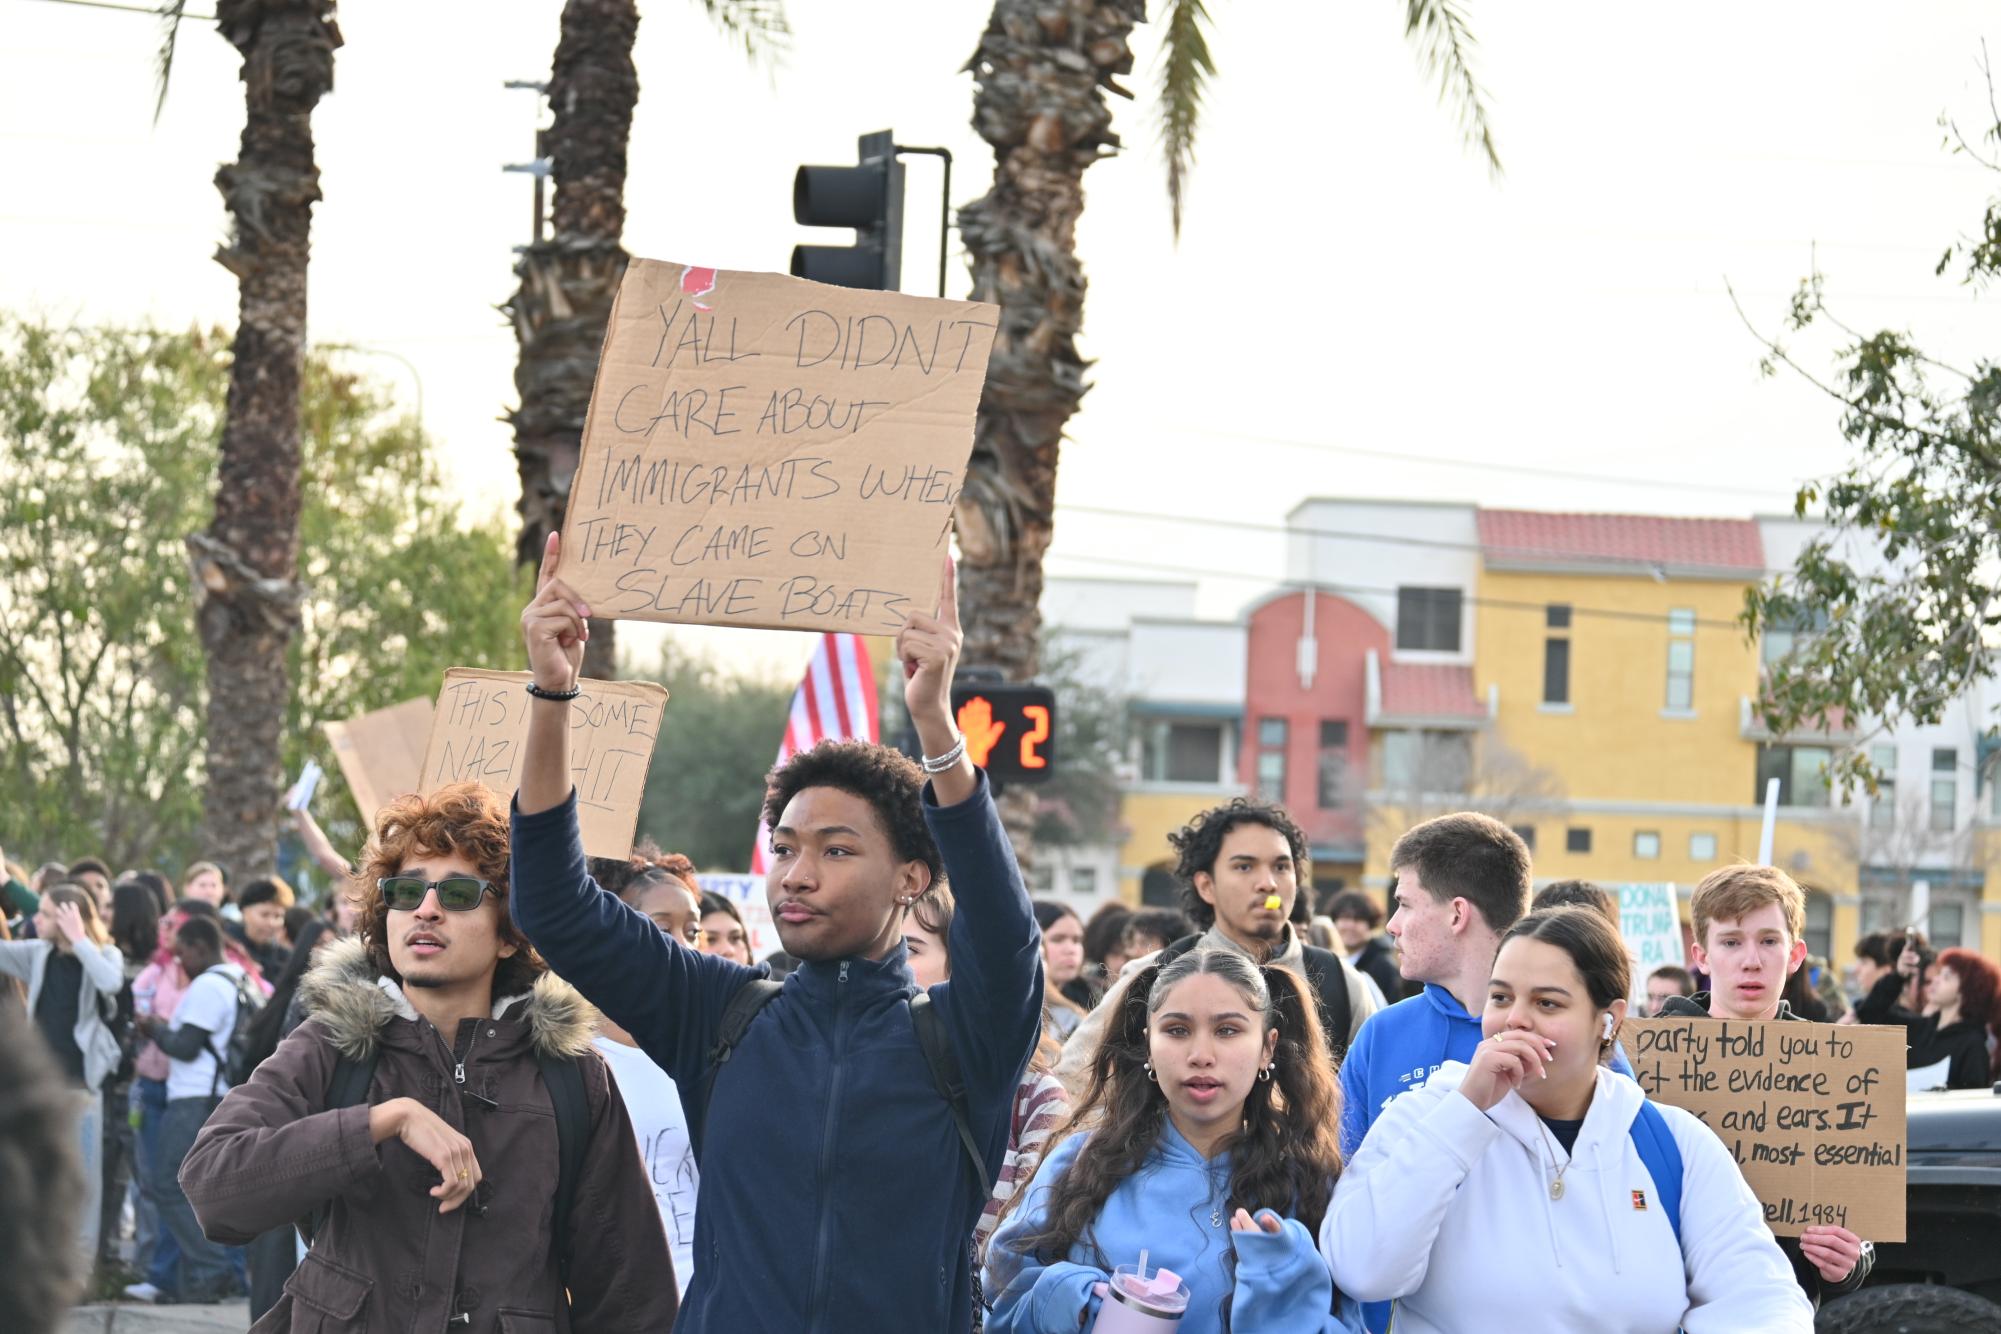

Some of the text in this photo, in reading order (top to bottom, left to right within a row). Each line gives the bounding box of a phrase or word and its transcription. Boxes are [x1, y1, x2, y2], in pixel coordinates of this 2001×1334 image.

[650, 299, 998, 375] YALL DIDN'T
[614, 384, 890, 439] CARE ABOUT
[597, 446, 841, 510] IMMIGRANTS
[577, 517, 846, 566] THEY CAME ON
[614, 568, 912, 628] SLAVE BOATS
[447, 681, 508, 729] THIS
[571, 694, 655, 739] SOME
[1020, 705, 1049, 769] 2
[437, 735, 645, 801] NAZI HIT
[1637, 1022, 1853, 1065] party told you to
[1679, 1054, 1720, 1092] the
[1728, 1062, 1831, 1096] evidence
[1846, 1067, 1879, 1095] of
[1721, 1101, 1766, 1133] and
[1752, 1143, 1805, 1166] most
[1814, 1142, 1901, 1167] essential
